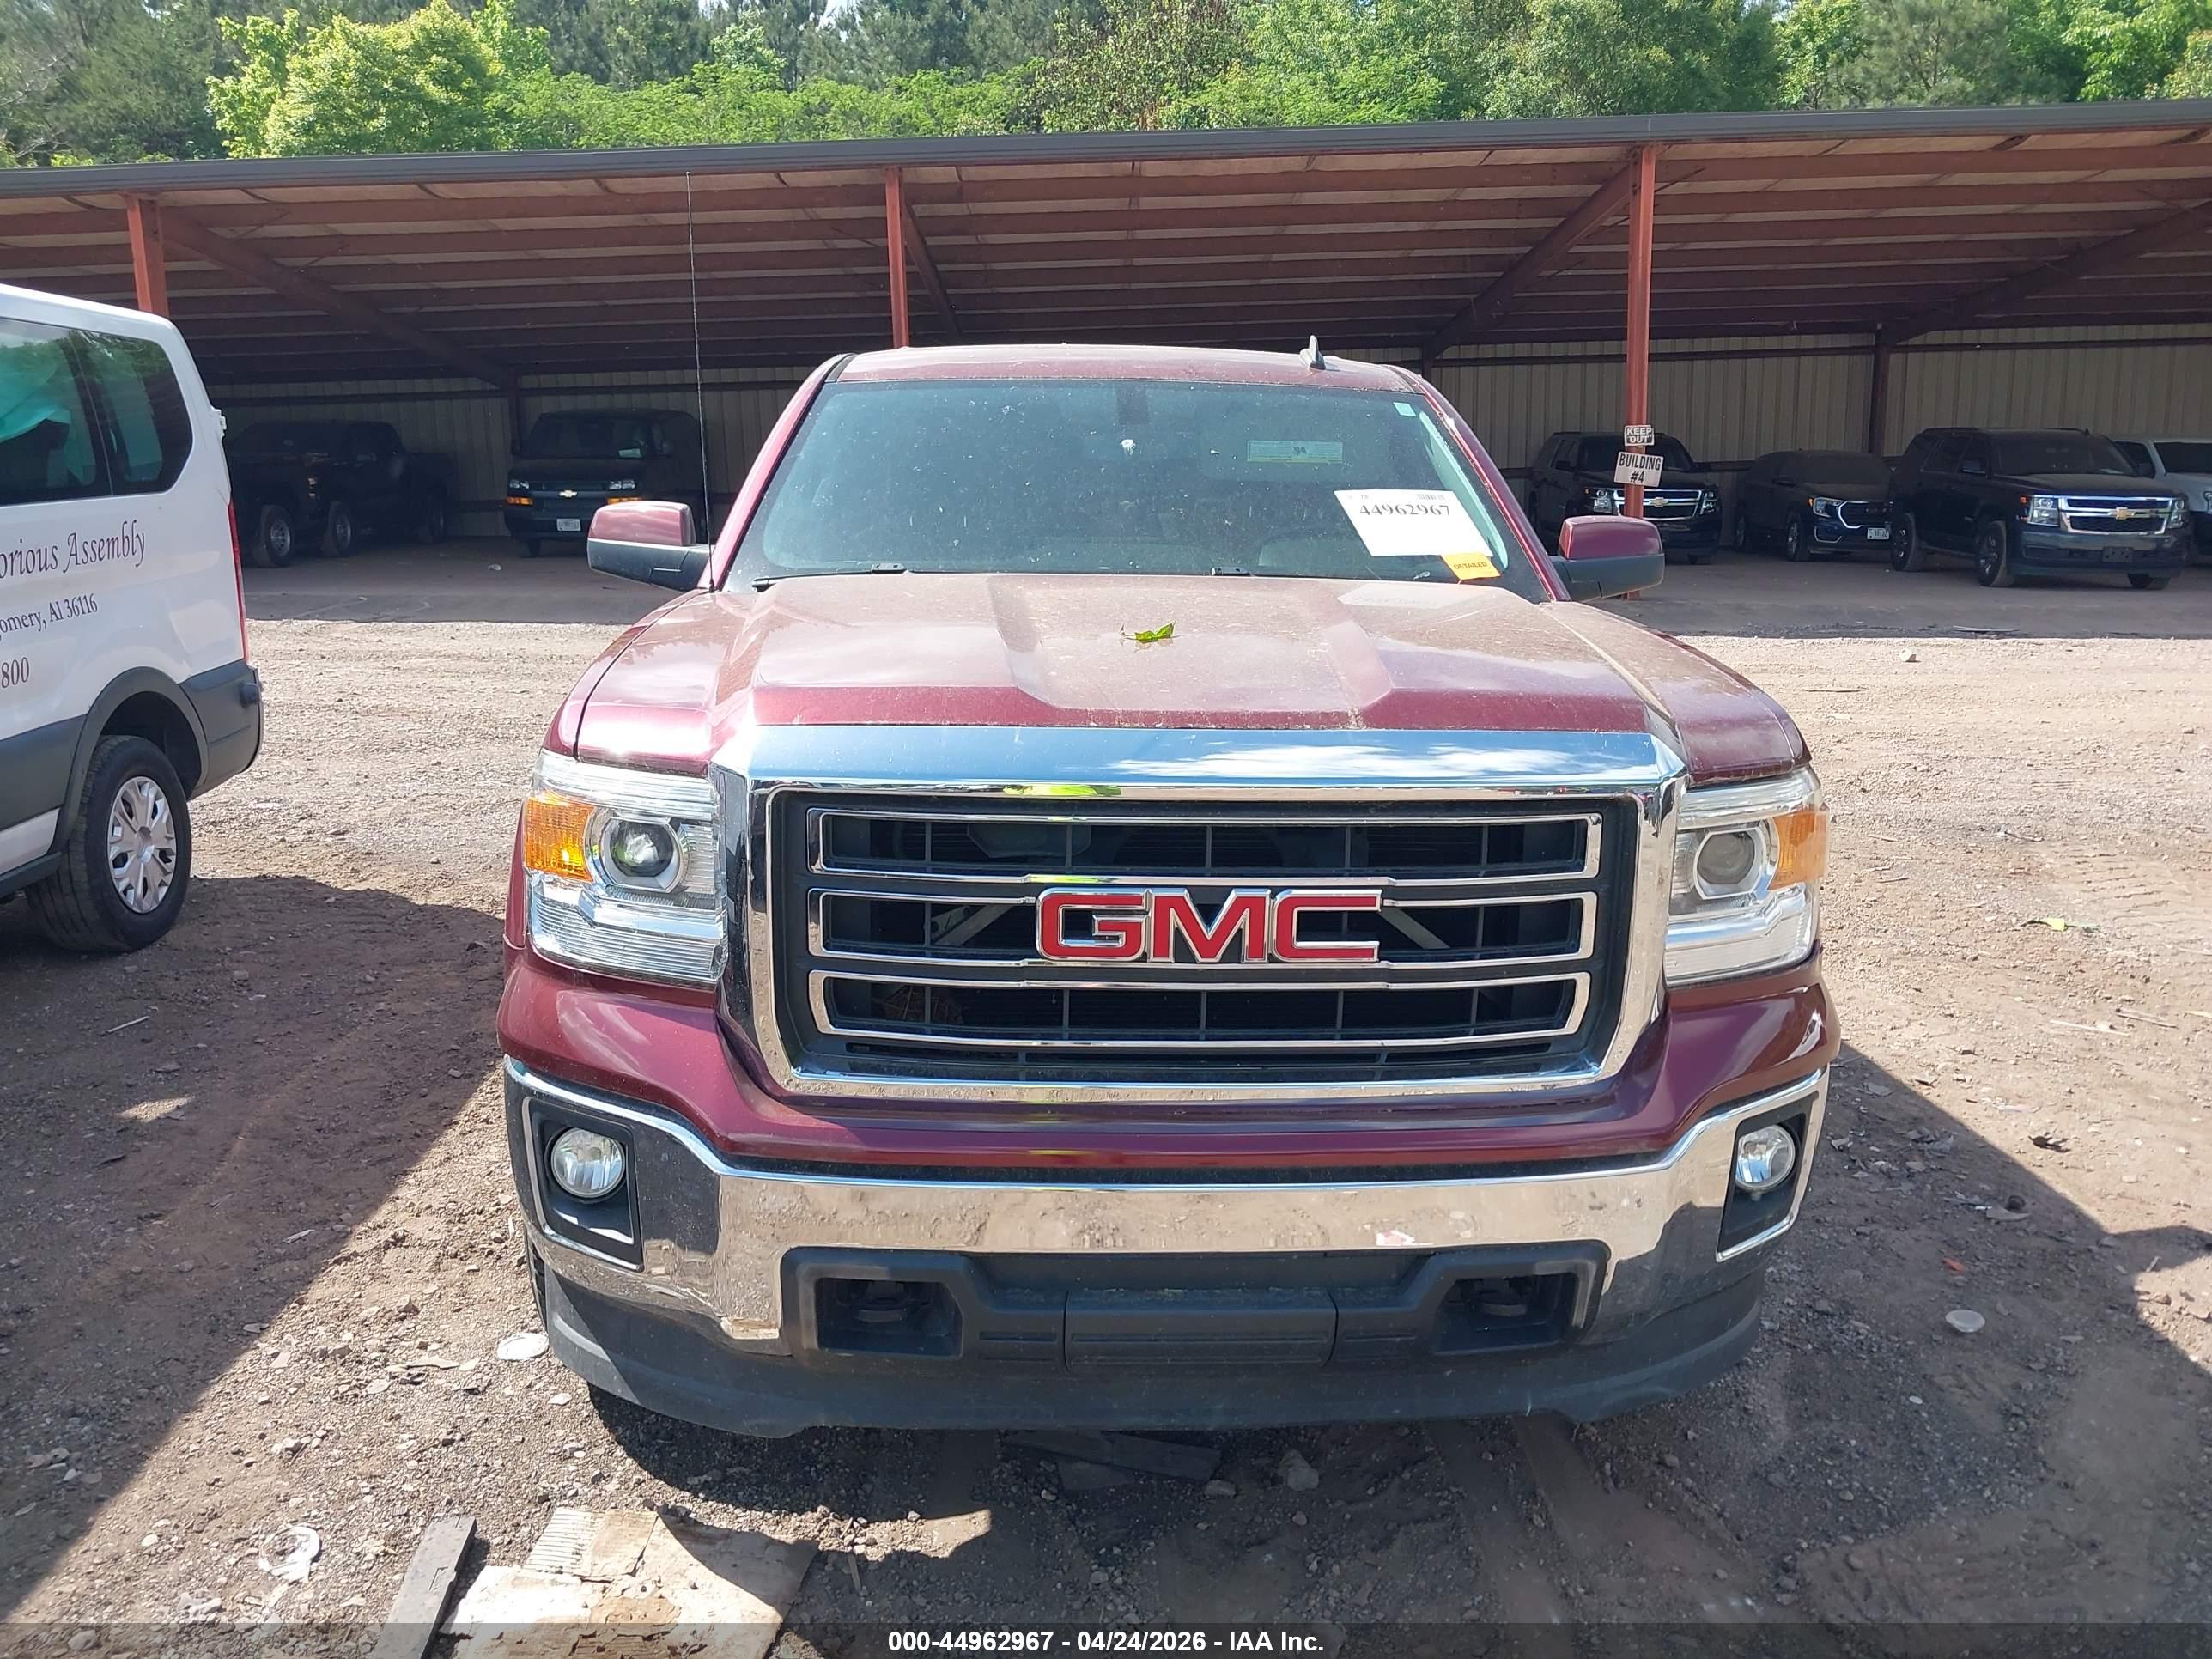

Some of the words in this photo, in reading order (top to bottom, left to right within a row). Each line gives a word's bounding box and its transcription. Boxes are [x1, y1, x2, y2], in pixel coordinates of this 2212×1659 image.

[1619, 453, 1662, 471] BUILDING
[1630, 470, 1644, 483] #4
[1359, 504, 1450, 516] 44962967
[63, 519, 145, 574] Assembly
[1453, 562, 1488, 570] DETAILED
[0, 611, 47, 638] omery,
[64, 592, 98, 618] 36116
[1, 656, 30, 689] 800
[1036, 887, 1382, 963] GMC
